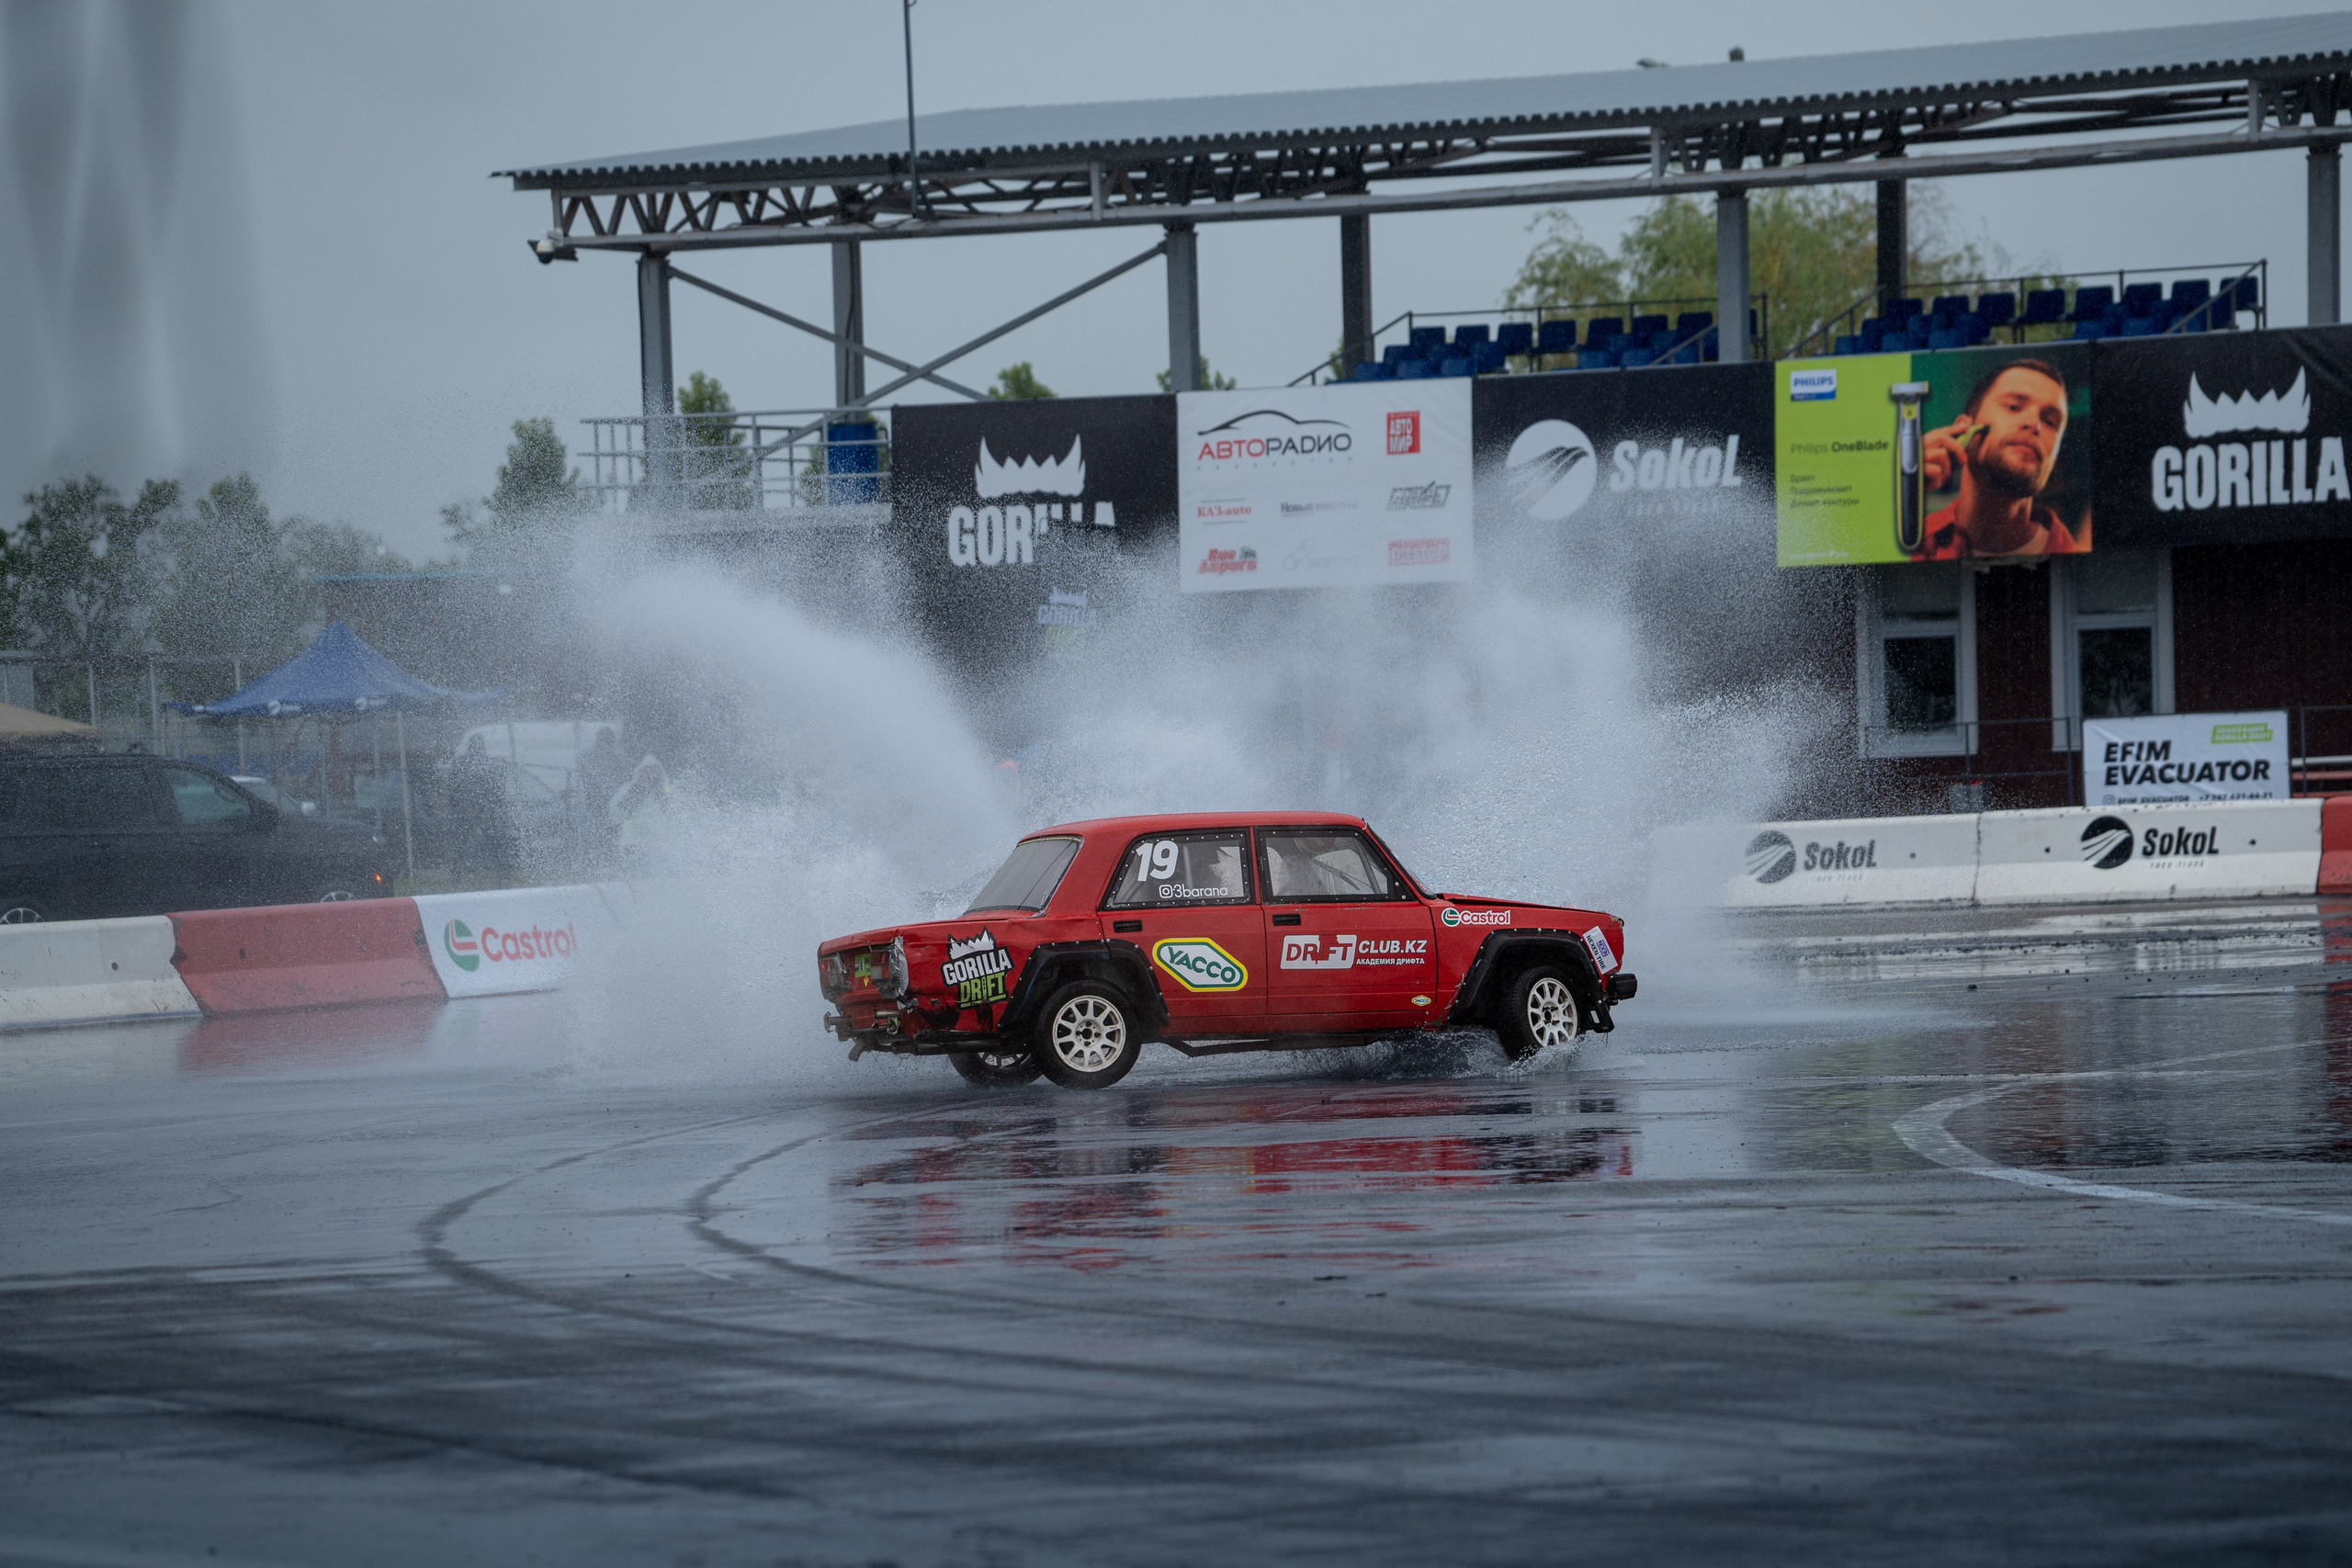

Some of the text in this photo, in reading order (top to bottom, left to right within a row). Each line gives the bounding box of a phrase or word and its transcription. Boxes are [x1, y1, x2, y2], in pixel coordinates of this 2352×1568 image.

[1793, 376, 1834, 387] PHILIPS
[1389, 418, 1413, 435] АВТО
[1389, 435, 1413, 452] МИР
[1791, 440, 1889, 454] Philips OneBlade
[2151, 435, 2351, 512] GORILLA
[2104, 739, 2171, 762] EFIM
[2105, 759, 2270, 786] EVACUATOR
[1136, 840, 1179, 882] 19
[1461, 909, 1510, 924] Castrol
[481, 919, 579, 962] Castrol
[1358, 940, 1427, 953] CLUB.KZ
[1586, 935, 1606, 970] NEXEN TIRE
[943, 949, 1012, 985] GORILLA
[1168, 946, 1236, 983] YACCO
[1356, 957, 1425, 965] АКАДЕМИЯ ДРИФТА
[960, 971, 1005, 1002] DRIFT
